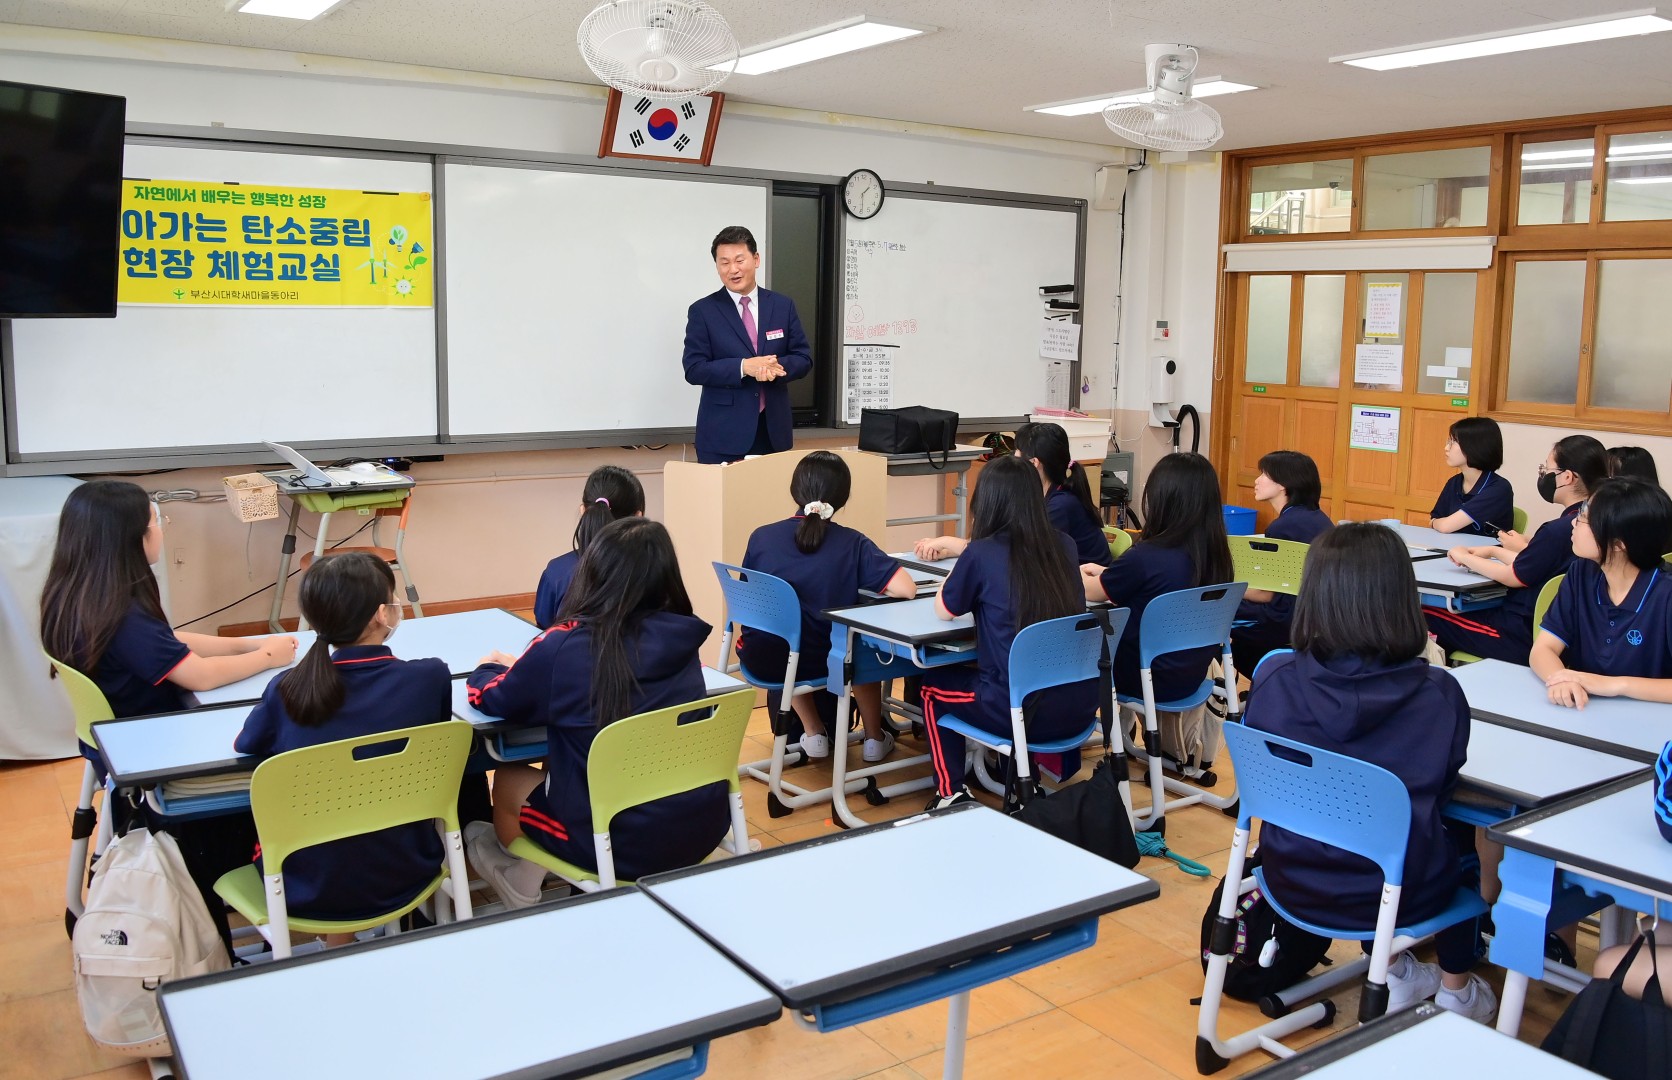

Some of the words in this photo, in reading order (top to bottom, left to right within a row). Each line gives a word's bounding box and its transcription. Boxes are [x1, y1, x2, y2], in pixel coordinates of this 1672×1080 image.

[133, 185, 197, 203] 자연에서
[201, 190, 246, 205] 배우는
[250, 192, 294, 208] 행복한
[298, 194, 327, 209] 성장
[241, 214, 371, 247] 탄소중립
[122, 247, 196, 280] 현장
[206, 250, 342, 282] 체험교실
[189, 289, 299, 301] 부산시대학새마을동아리
